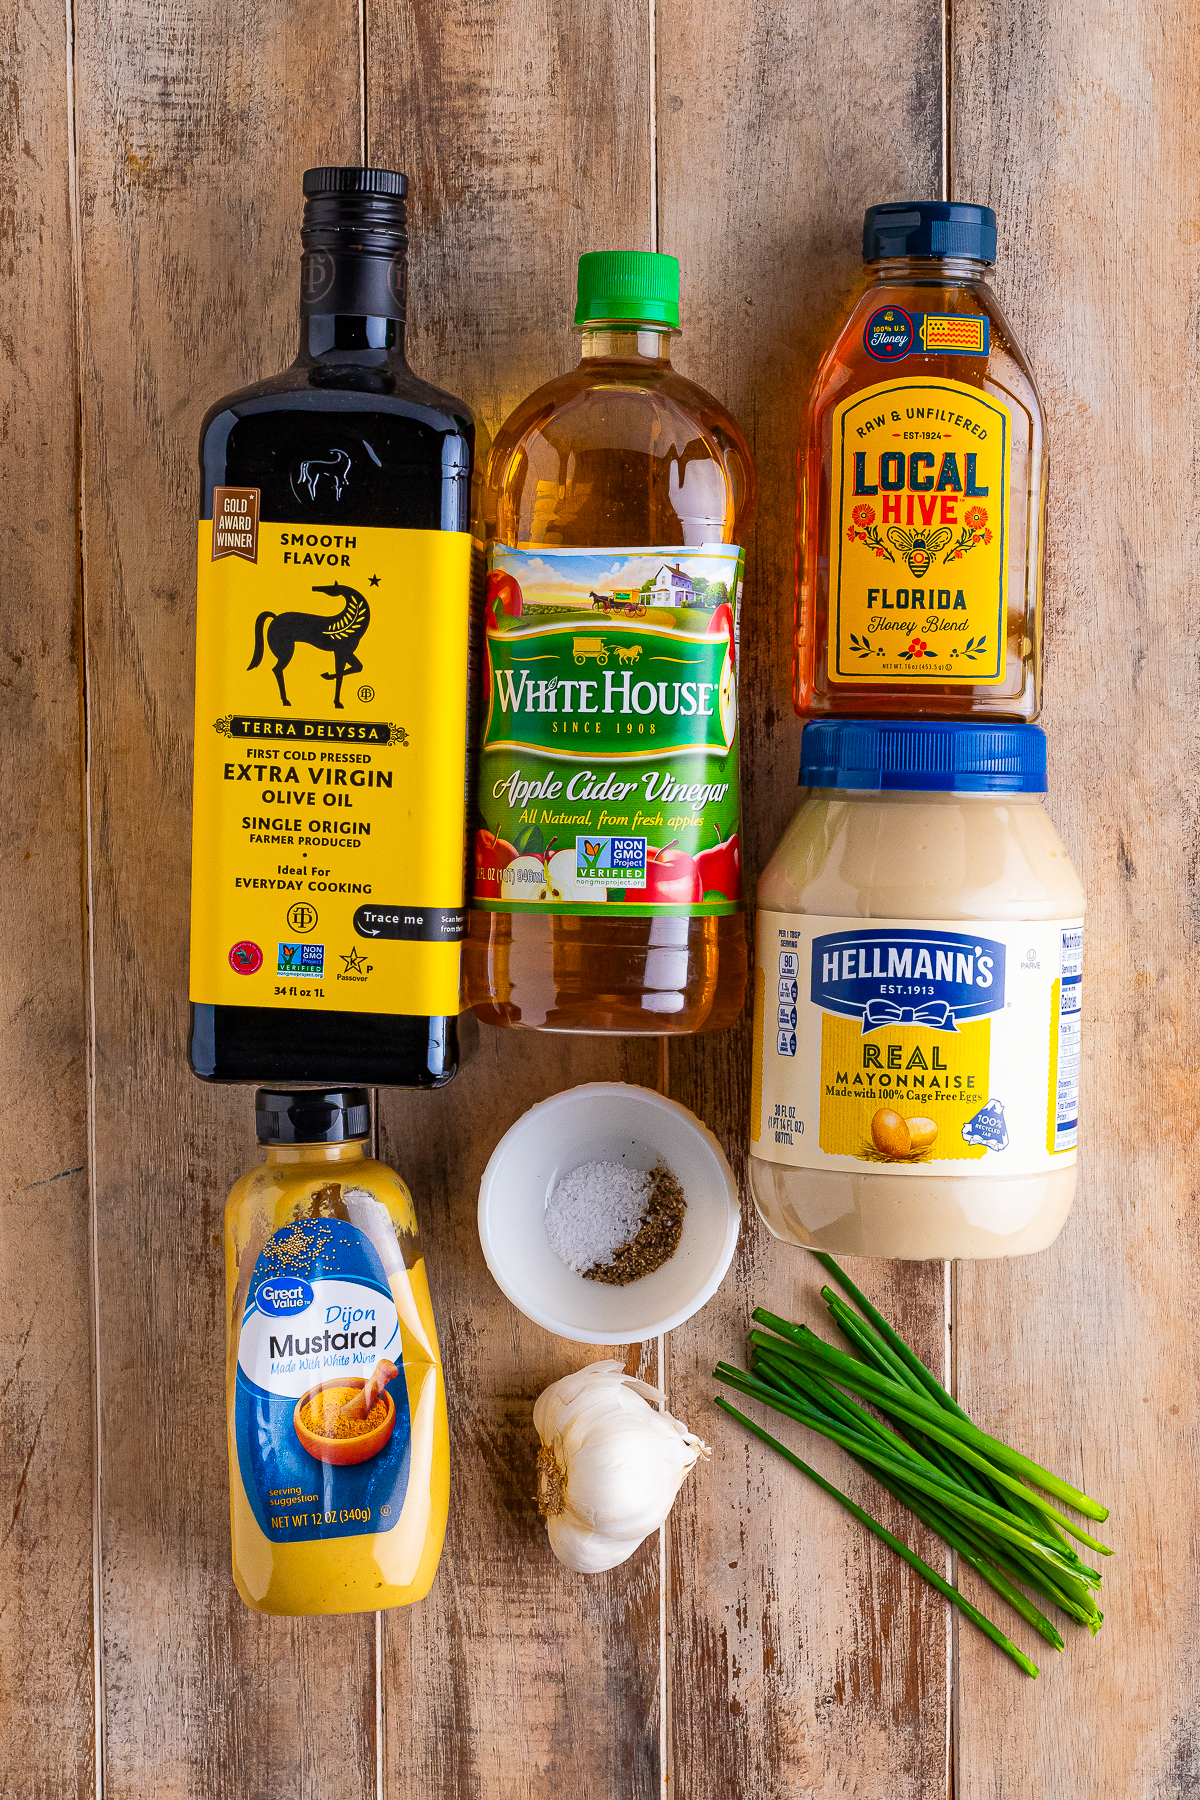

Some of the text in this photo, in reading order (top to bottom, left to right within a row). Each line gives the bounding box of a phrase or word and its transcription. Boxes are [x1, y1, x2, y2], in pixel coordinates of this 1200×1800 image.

[871, 332, 908, 346] Honey
[856, 408, 988, 441] RAW & UNFILTERED
[852, 452, 989, 497] LOCAL
[224, 498, 248, 513] GOLD
[882, 495, 958, 526] HIVE
[219, 516, 252, 531] AWARD
[217, 532, 252, 548] WINNER
[280, 534, 357, 548] SMOOTH
[284, 552, 350, 566] FLAVOR
[867, 588, 967, 610] FLORIDA
[867, 615, 969, 636] Honey Blend
[602, 670, 714, 715] HOUSE
[242, 722, 379, 740] TERRA DELYSSA
[552, 722, 656, 734] SINCE 1908
[246, 748, 372, 764] FIRST COLD PRESSED
[224, 764, 393, 788] EXTRA VIRGIN
[492, 769, 728, 811] Apple Cider Vinegar
[262, 790, 353, 808] OLIVE OIL
[242, 817, 371, 836] SINGLE ORIGIN
[518, 809, 704, 831] All Natural, from fresh apples
[249, 834, 361, 848] FARMER PRODUCED
[614, 840, 642, 849] NON
[614, 850, 643, 859] GMO
[277, 865, 330, 877] Ideal For
[614, 859, 642, 868] Project
[488, 868, 495, 880] OZ
[517, 868, 547, 883] 946mL
[580, 869, 642, 878] VERIFIED
[235, 878, 372, 894] EVERYDAY COOKING
[576, 879, 645, 887] nongmoproject.org
[364, 911, 424, 925] Trace me
[781, 940, 797, 948] SERVING
[280, 964, 322, 972] VERIFIED
[784, 955, 793, 967] 90
[274, 987, 286, 995] 34
[289, 987, 297, 996] fl
[314, 989, 325, 997] 1L
[863, 1044, 947, 1070] REAL
[836, 1071, 976, 1088] MAYONNAISE
[826, 1085, 982, 1104] Made with 100% Cage Free Eggs
[775, 1104, 795, 1119] 30 FL OZ
[773, 1117, 779, 1129] PT
[780, 1118, 785, 1130] 14
[787, 1120, 793, 1132] FL
[795, 1120, 804, 1134] OZ)
[978, 1114, 1002, 1128] 100%
[975, 1124, 1000, 1134] RECYCLED
[262, 1286, 304, 1300] Great
[272, 1298, 304, 1309] Value
[324, 1306, 375, 1331] Dijon
[270, 1326, 376, 1358] Mustard
[270, 1352, 376, 1374] Made With White Wine
[269, 1486, 302, 1496] serving
[270, 1494, 318, 1506] suggestion
[271, 1516, 289, 1528] NET
[292, 1514, 308, 1527] WT
[311, 1512, 322, 1525] 12
[324, 1510, 337, 1524] OZ
[340, 1507, 371, 1523] (340g)
